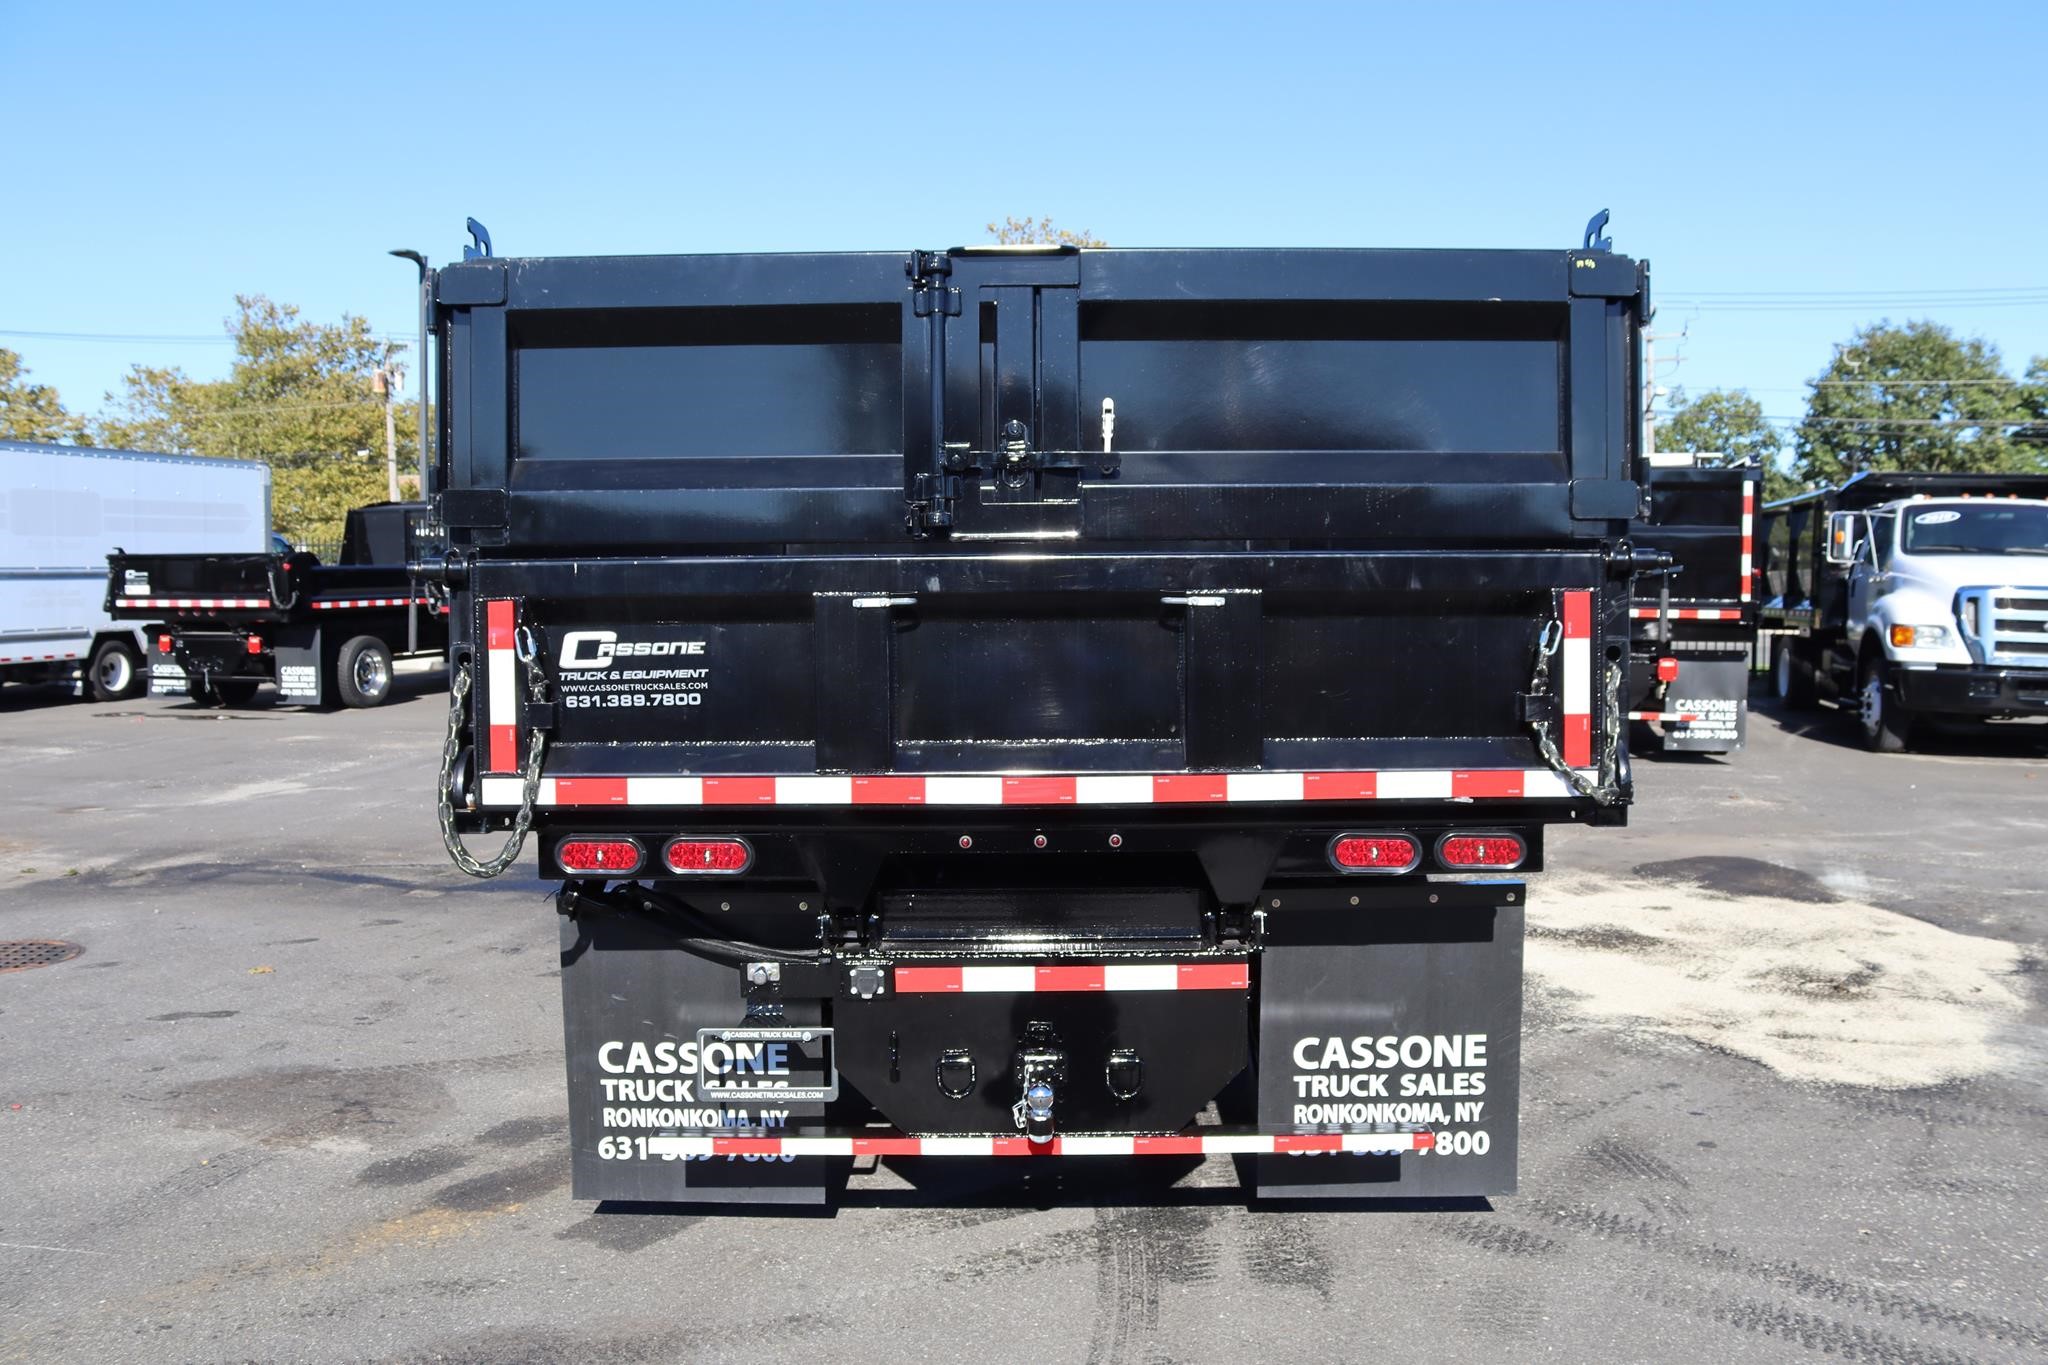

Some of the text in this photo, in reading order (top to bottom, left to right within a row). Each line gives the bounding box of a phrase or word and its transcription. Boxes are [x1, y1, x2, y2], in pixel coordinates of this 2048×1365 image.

[559, 669, 709, 681] TRUCK & EQUIPMENT
[561, 682, 709, 693] WWW.CASSONETRUCKSALES.COM
[566, 693, 702, 708] 631.389.7800
[1675, 699, 1738, 712] CASSONE
[598, 1041, 790, 1075] CASSONE
[1293, 1034, 1487, 1070] CASSONE
[600, 1079, 695, 1102] TRUCK
[1293, 1072, 1486, 1098] TRUCK SALES
[710, 1091, 824, 1099] WWW.CASSONETRUCKSALES.COM
[761, 1109, 790, 1128] NY
[1294, 1101, 1485, 1126] RONKONKOMA, NY
